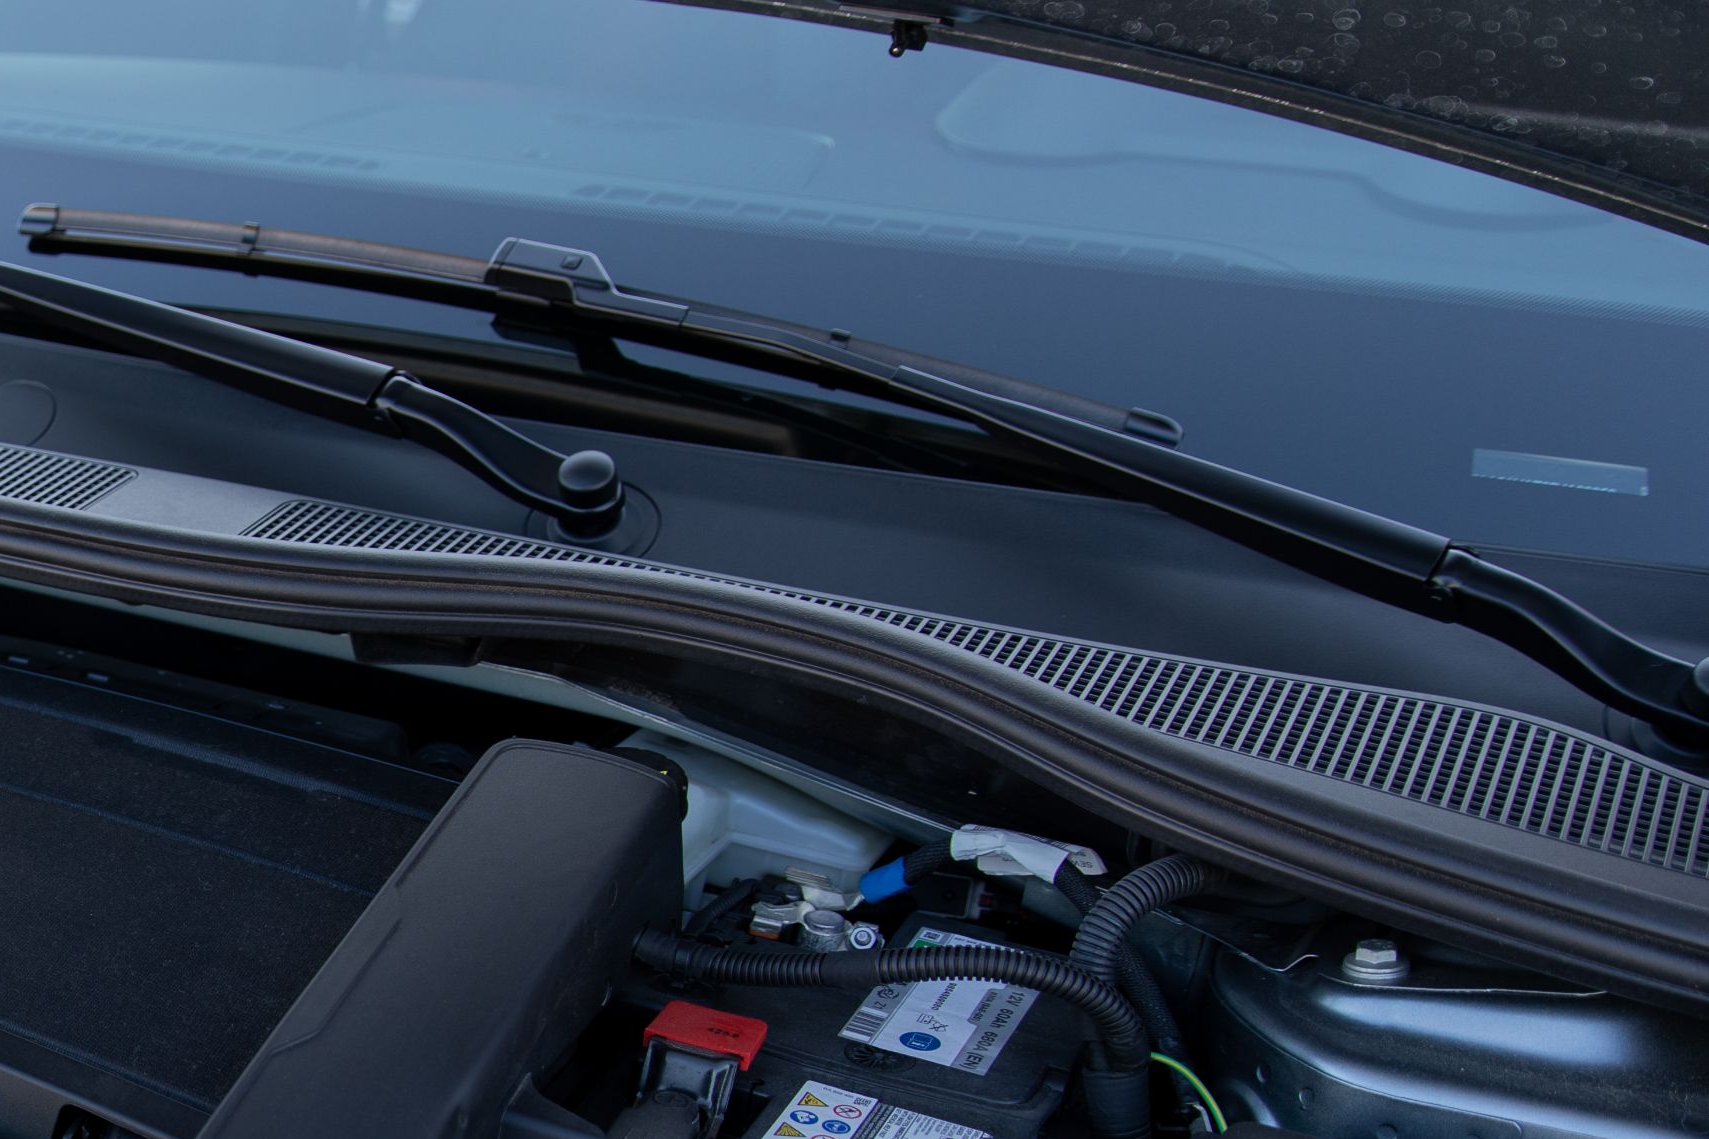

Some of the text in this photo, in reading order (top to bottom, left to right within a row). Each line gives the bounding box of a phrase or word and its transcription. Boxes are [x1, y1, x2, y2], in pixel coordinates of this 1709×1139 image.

[1008, 991, 1025, 1007] 12V
[989, 1008, 1015, 1029] 60Ah
[977, 1031, 998, 1054] 680A
[961, 1053, 985, 1071] (EN)
